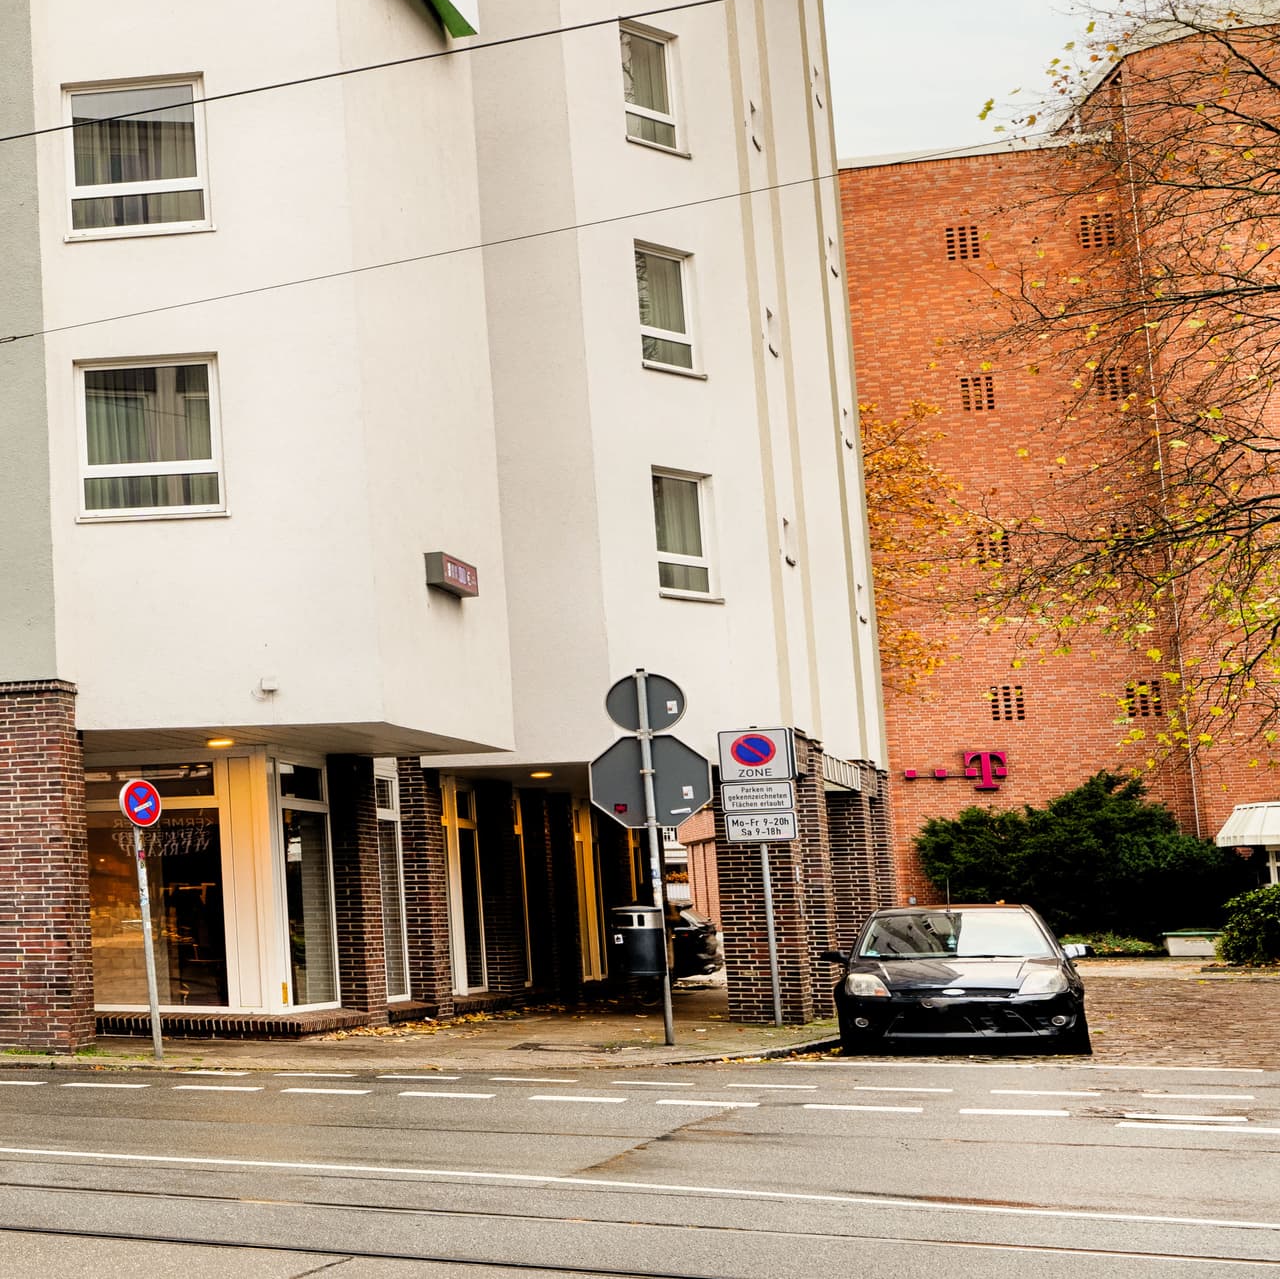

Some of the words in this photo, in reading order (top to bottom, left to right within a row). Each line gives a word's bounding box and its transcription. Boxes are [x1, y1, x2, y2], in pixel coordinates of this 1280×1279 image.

[738, 768, 773, 778] ZONE
[728, 793, 788, 802] gekennzeichneten
[741, 828, 752, 836] Sa
